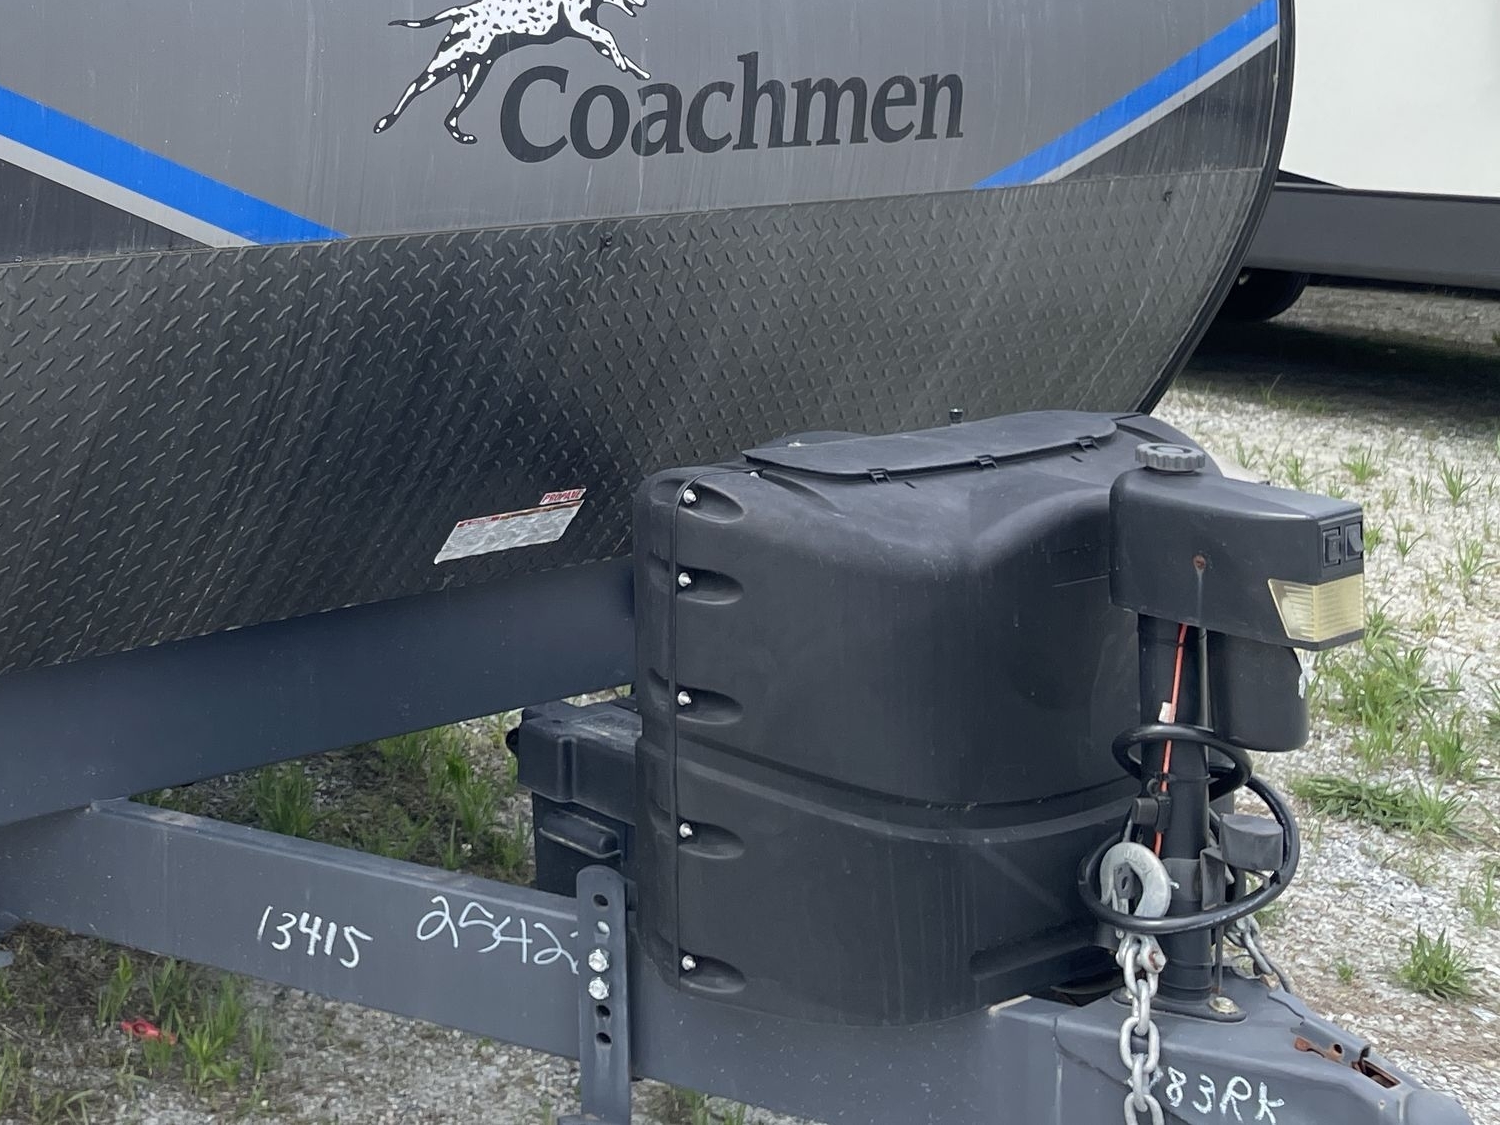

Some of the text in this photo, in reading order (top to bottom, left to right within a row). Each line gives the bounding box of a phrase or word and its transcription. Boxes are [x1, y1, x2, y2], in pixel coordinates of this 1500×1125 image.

[500, 51, 964, 163] Coachmen
[257, 895, 580, 974] 13415 2542
